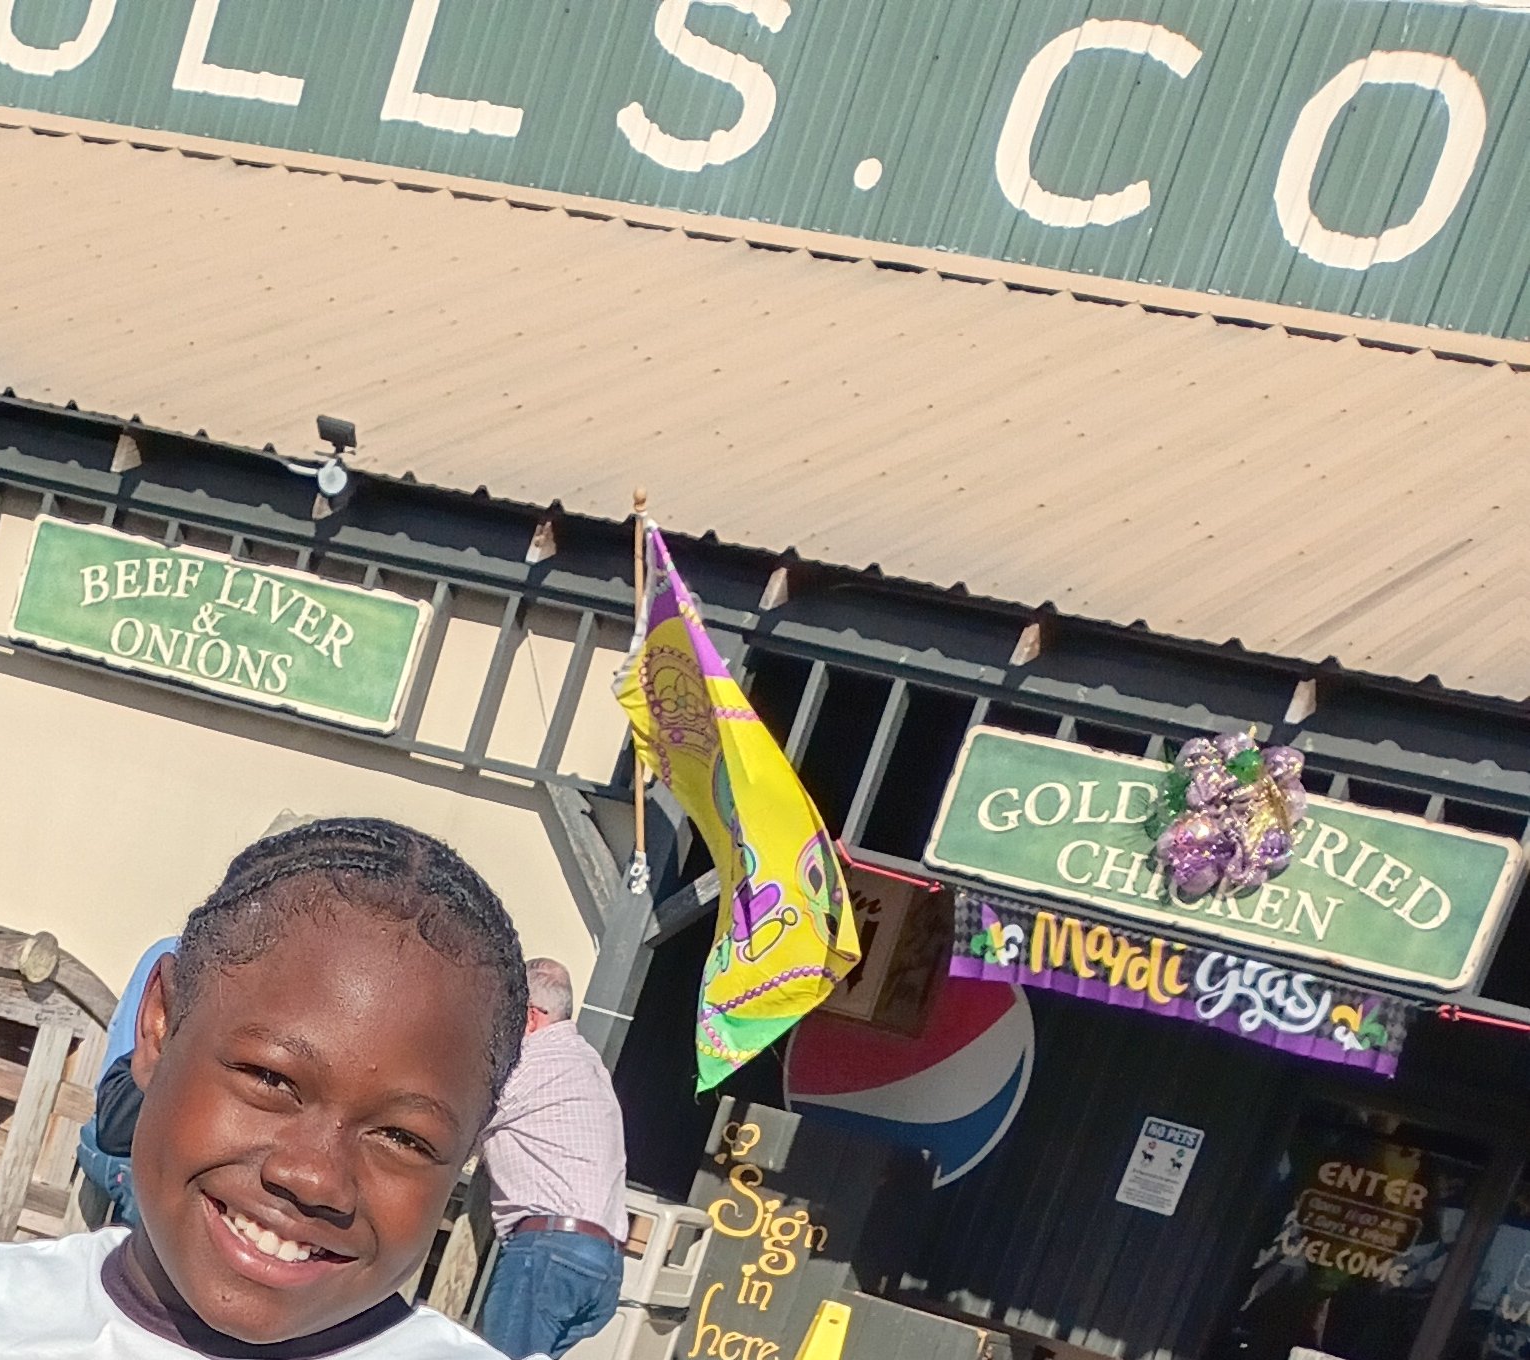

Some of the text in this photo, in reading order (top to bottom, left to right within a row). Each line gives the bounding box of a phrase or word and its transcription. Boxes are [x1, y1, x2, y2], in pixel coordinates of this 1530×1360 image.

[80, 557, 356, 669] BEEF LIVER
[192, 602, 227, 637] &
[109, 616, 294, 695] ONIONS
[976, 779, 1162, 834] GOLD
[1029, 910, 1332, 1034] Mardi Gras
[1318, 1161, 1429, 1210] ENTER
[707, 1163, 829, 1276] Sign
[736, 1263, 774, 1312] in
[1278, 1234, 1408, 1287] WELCOME
